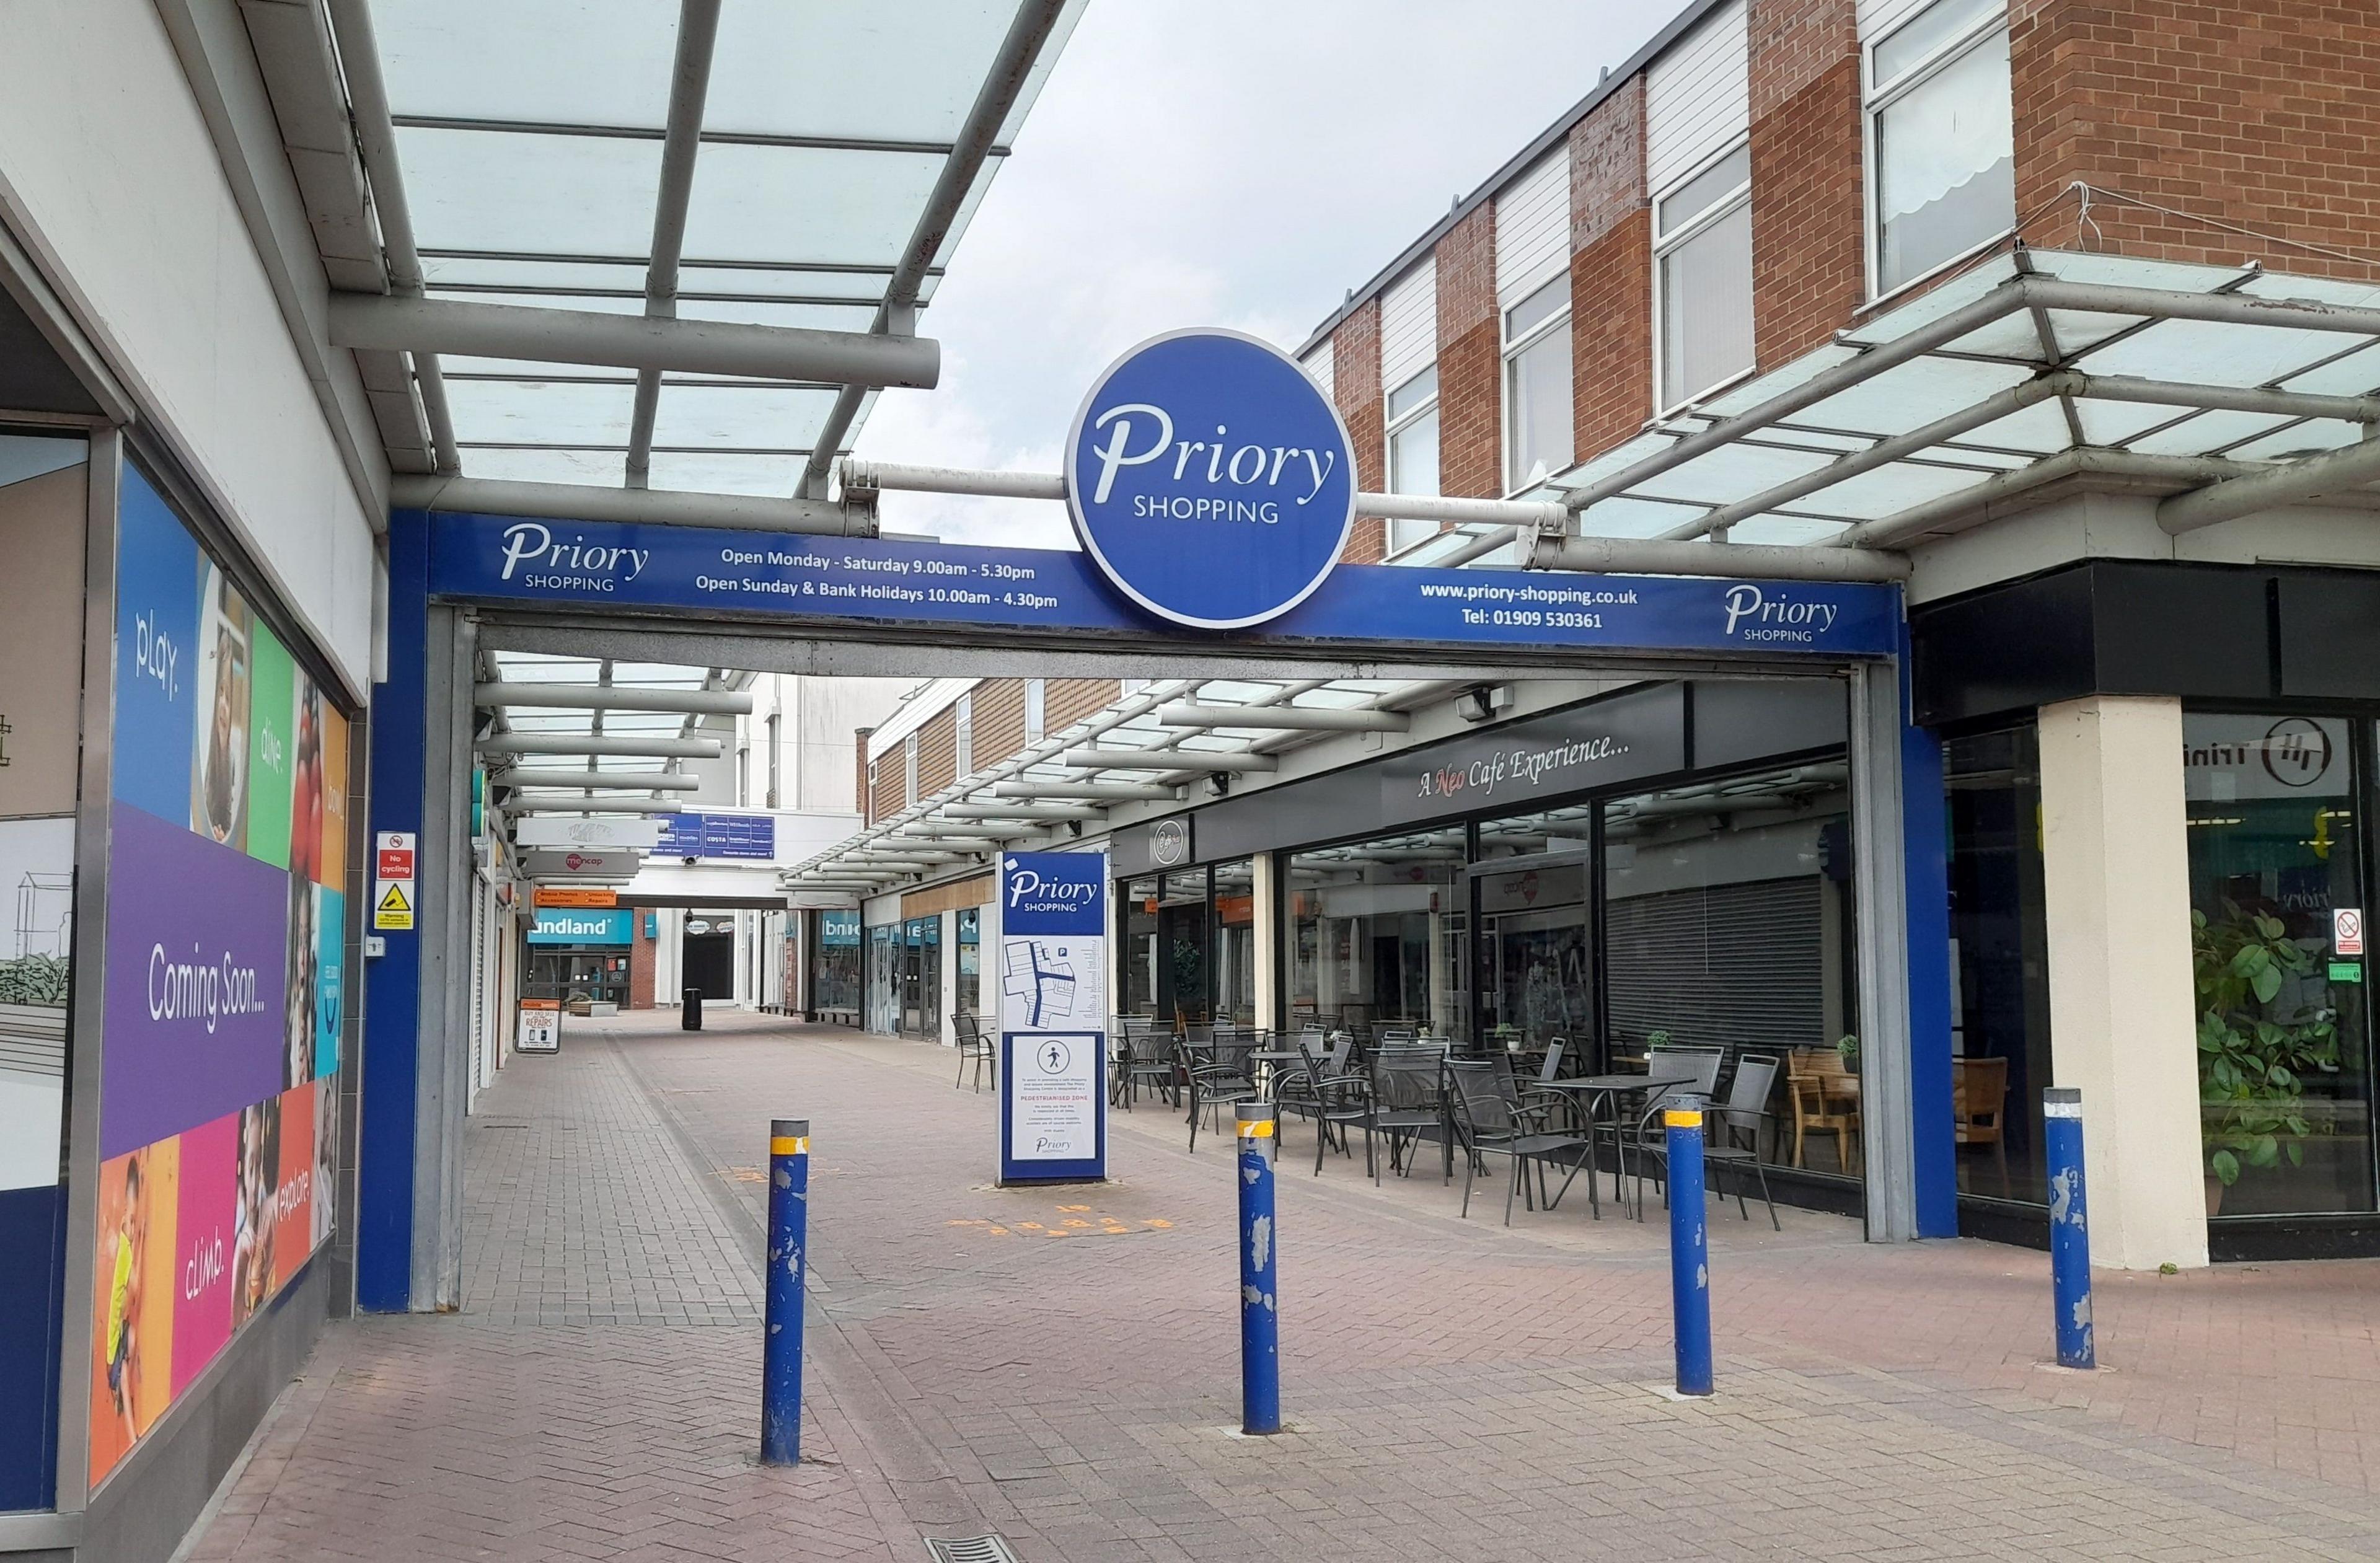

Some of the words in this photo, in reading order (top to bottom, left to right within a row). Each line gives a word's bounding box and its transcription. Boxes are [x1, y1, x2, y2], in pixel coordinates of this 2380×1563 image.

[1093, 403, 1334, 505] Priory
[1133, 495, 1279, 524] SHOPPING
[501, 522, 650, 582] Priory
[721, 548, 763, 566] Open
[768, 552, 830, 571] Monday
[844, 556, 909, 575] Saturday
[913, 560, 967, 576] 9.00am
[981, 564, 1035, 580] 5.30pm
[525, 574, 615, 592] SHOPPING
[695, 576, 738, 593] Open
[743, 579, 798, 597] Sunday
[802, 581, 816, 595] &
[819, 583, 857, 599] Bank
[860, 585, 924, 602] Holidays
[928, 589, 991, 605] 10.00am
[1004, 593, 1058, 609] 4.30pm
[1421, 584, 1638, 606] www.priory-shopping.co.uk
[1462, 609, 1489, 625] Tel:
[1493, 610, 1541, 626] 01909
[1546, 612, 1602, 628] 530361
[1725, 584, 1837, 633] Priory
[1744, 629, 1812, 642] SHOPPING
[1418, 772, 1431, 798] A
[1435, 763, 1465, 798] Neo
[1470, 752, 1505, 795] Café
[1510, 736, 1629, 785] Experience...
[381, 866, 410, 874] cycling
[1010, 871, 1097, 908] Priory
[1025, 903, 1077, 912] SHOPPING
[149, 941, 218, 1034] Coming
[222, 951, 265, 1015] Soon...
[526, 1018, 552, 1026] REPAIRS
[1036, 1137, 1071, 1152] Priory
